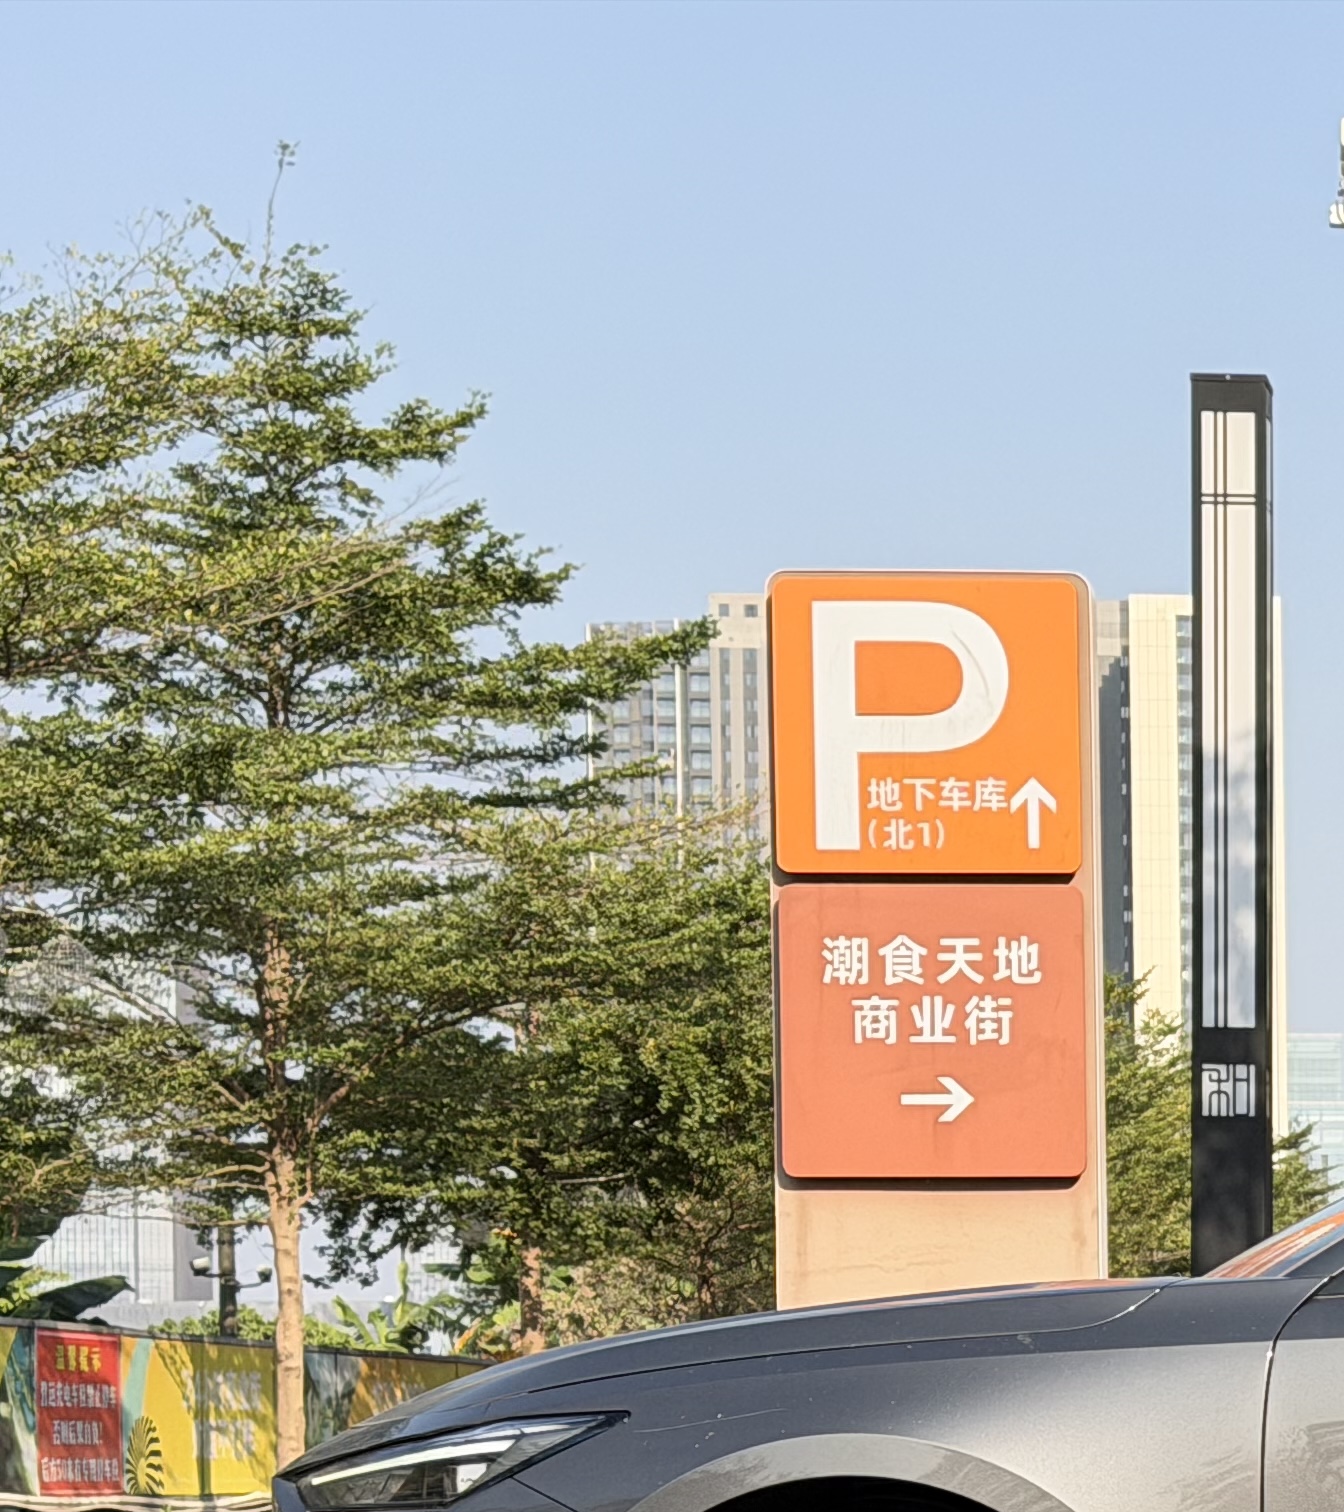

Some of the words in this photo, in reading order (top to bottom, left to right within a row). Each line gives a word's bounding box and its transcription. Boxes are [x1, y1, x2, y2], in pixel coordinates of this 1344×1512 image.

[811, 600, 1009, 850] P
[867, 778, 1009, 812] 地下车库
[821, 935, 1042, 985] 潮食天地
[851, 994, 1013, 1046] 商业街
